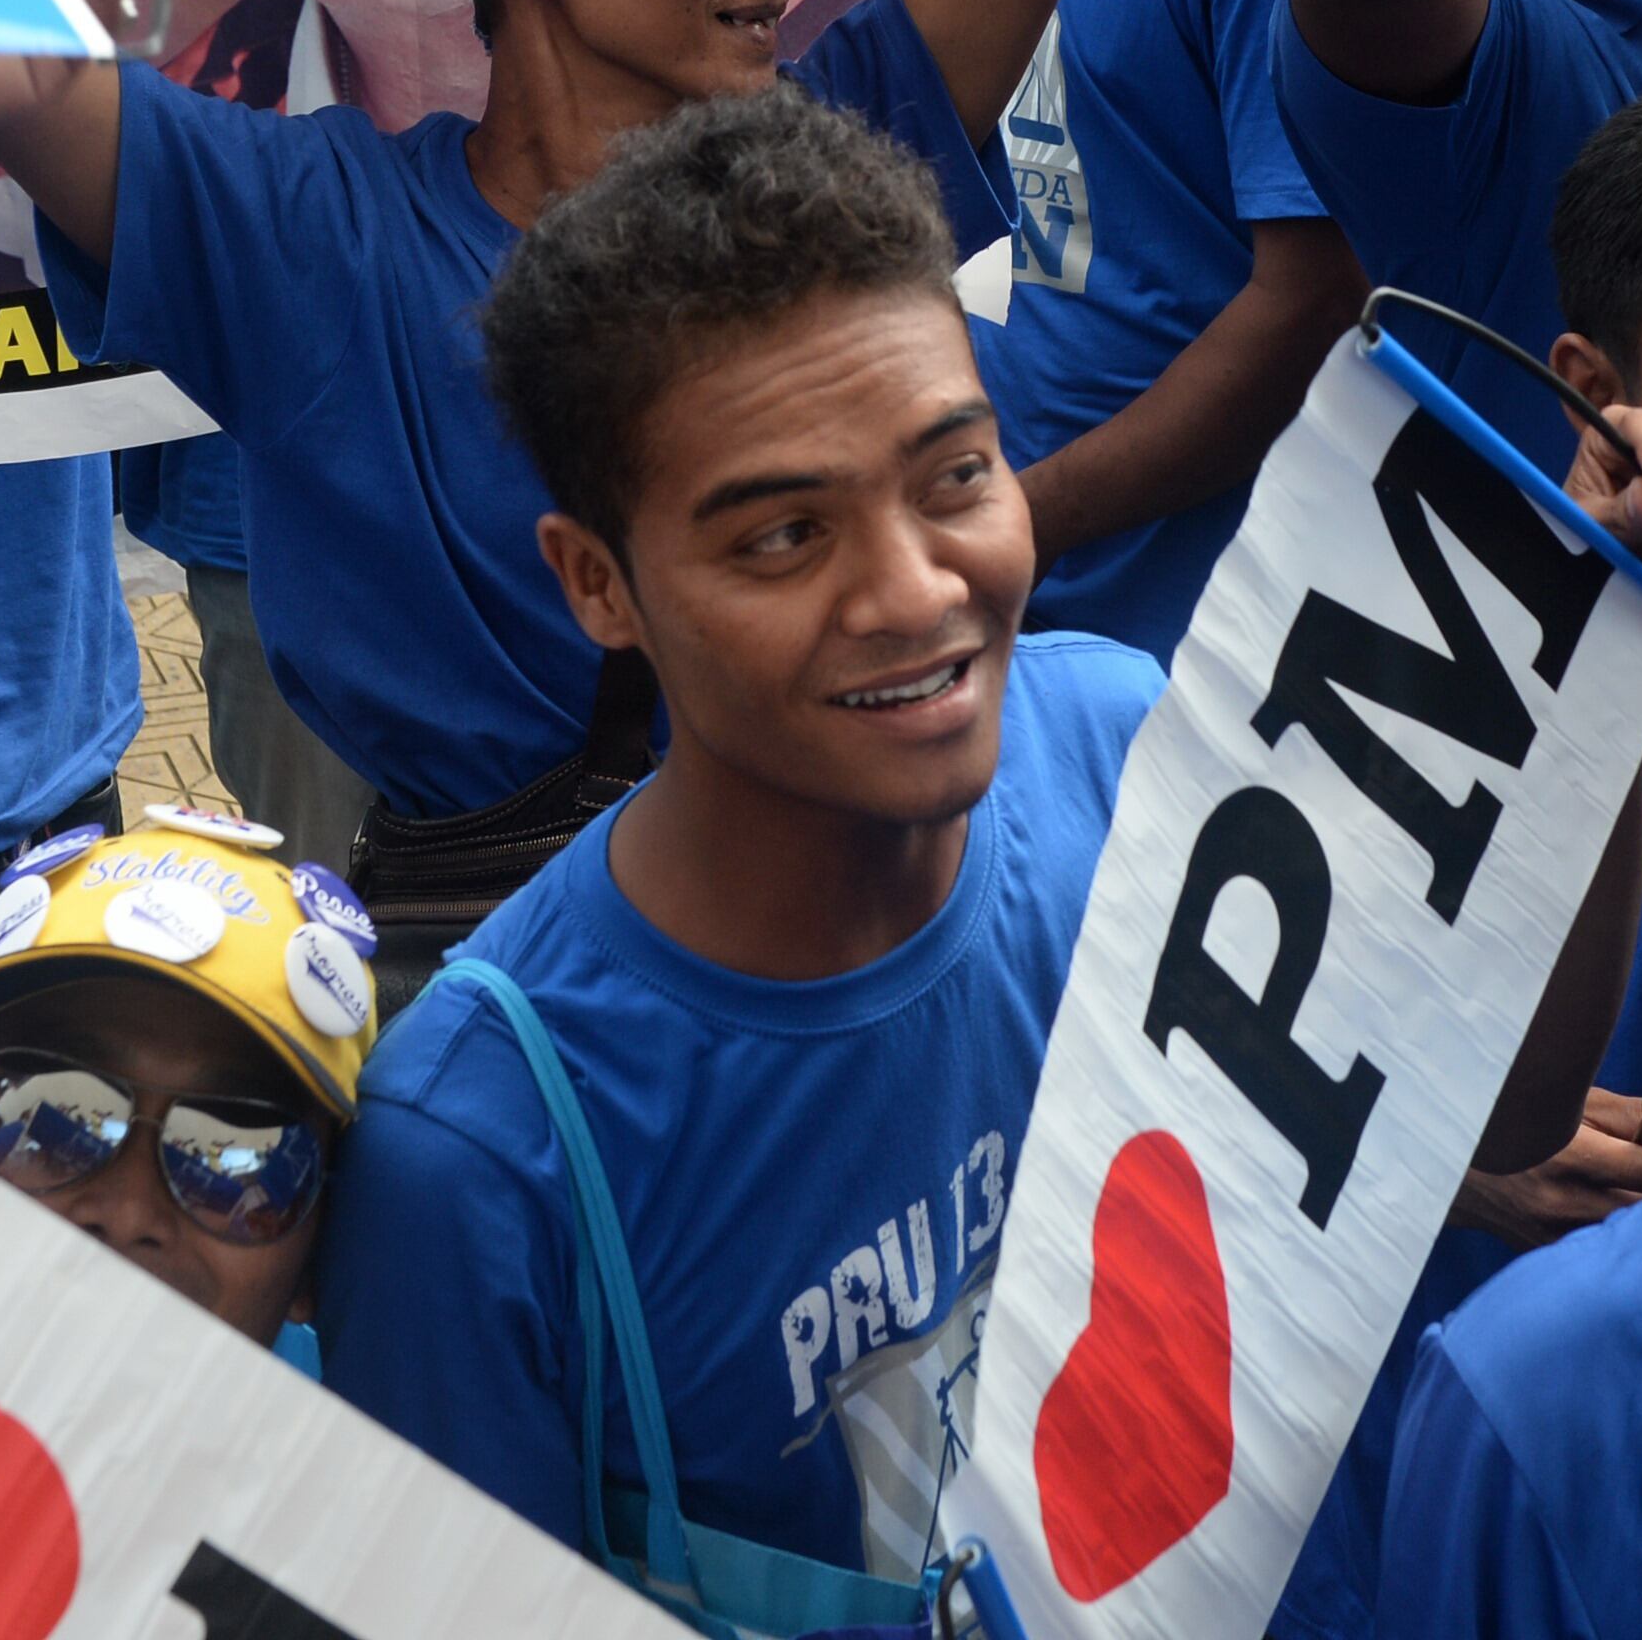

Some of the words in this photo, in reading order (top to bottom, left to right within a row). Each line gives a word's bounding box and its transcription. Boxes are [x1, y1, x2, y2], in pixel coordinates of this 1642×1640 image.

[80, 849, 270, 926] Stability
[1143, 407, 1616, 1232] PM
[780, 1198, 938, 1418] PRU
